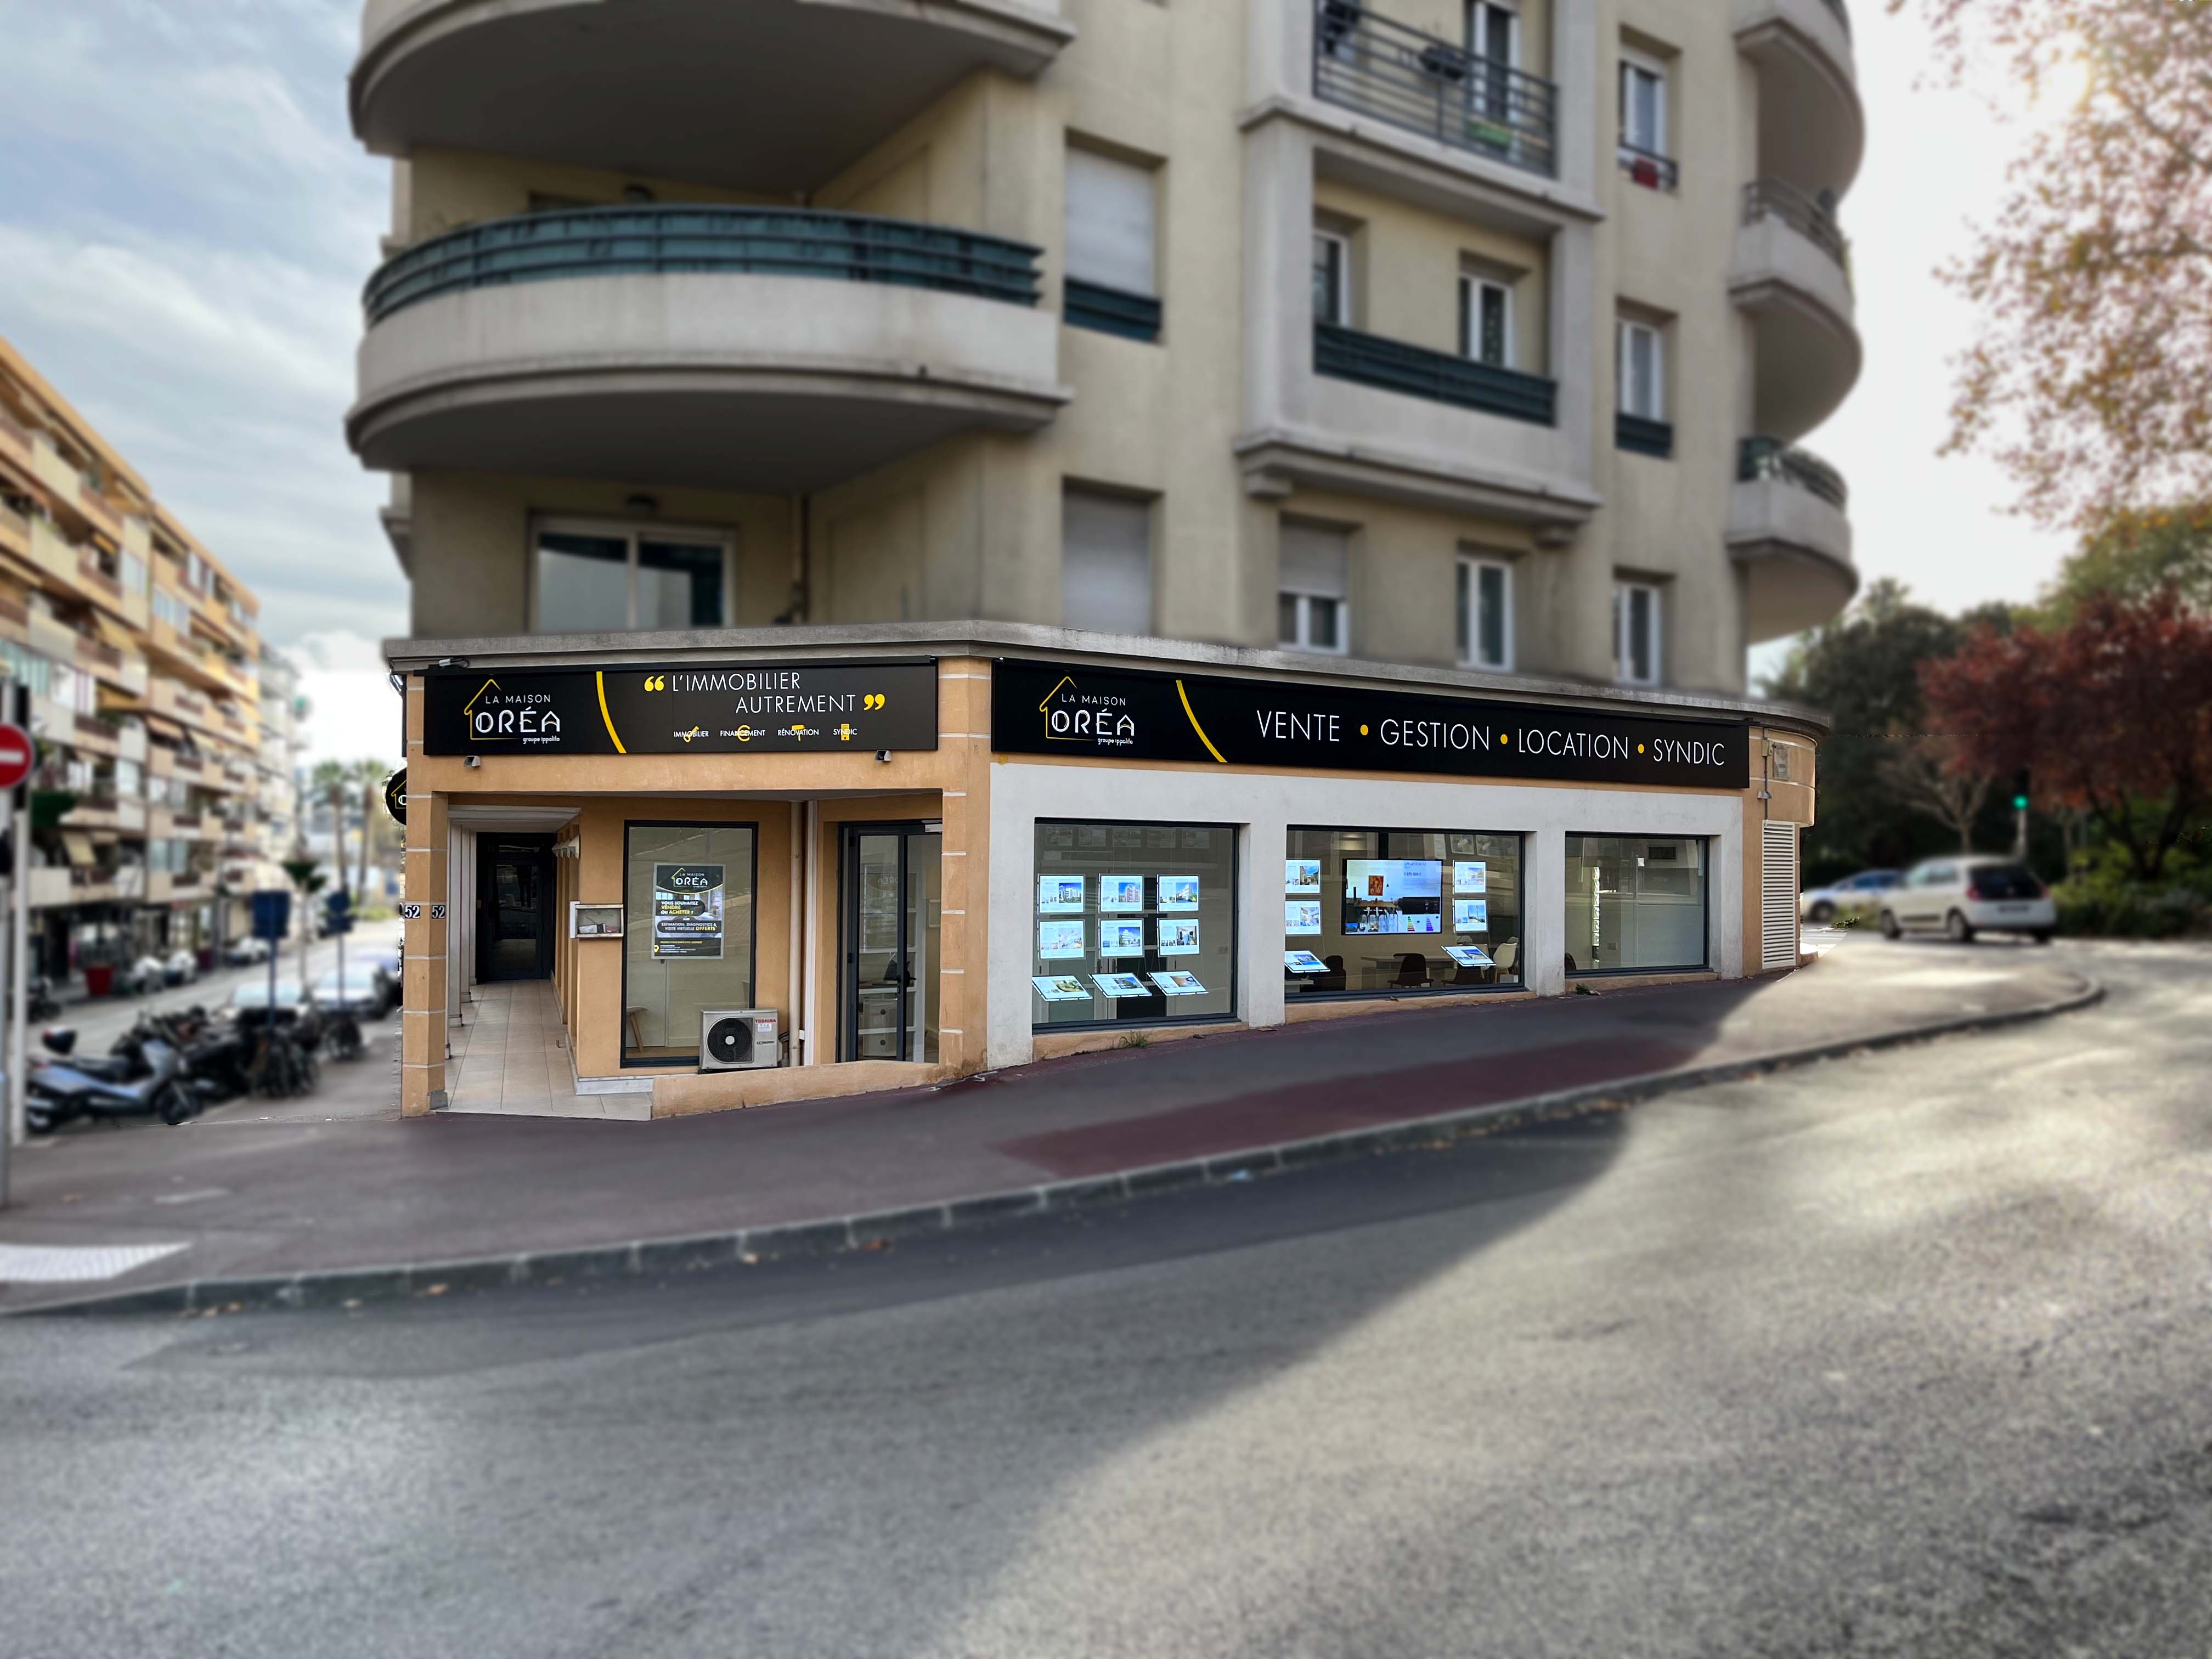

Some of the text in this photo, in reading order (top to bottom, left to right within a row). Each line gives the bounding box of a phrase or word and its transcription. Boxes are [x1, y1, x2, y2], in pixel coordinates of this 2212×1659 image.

[486, 694, 551, 704] LA MAISON
[735, 694, 856, 714] AUTREMENT
[1062, 693, 1126, 706] LA MAISON
[475, 706, 560, 733] ORÉA
[1051, 708, 1135, 736] ORÉA
[1256, 710, 1340, 742] VENTE
[777, 728, 819, 736] RÉNOVATION
[1380, 719, 1489, 751] GESTION
[1519, 728, 1628, 760] LOCATION
[1653, 738, 1724, 766] SYNDIC
[675, 877, 708, 885] ORÉA
[405, 905, 420, 918] 52
[432, 906, 445, 918] 52
